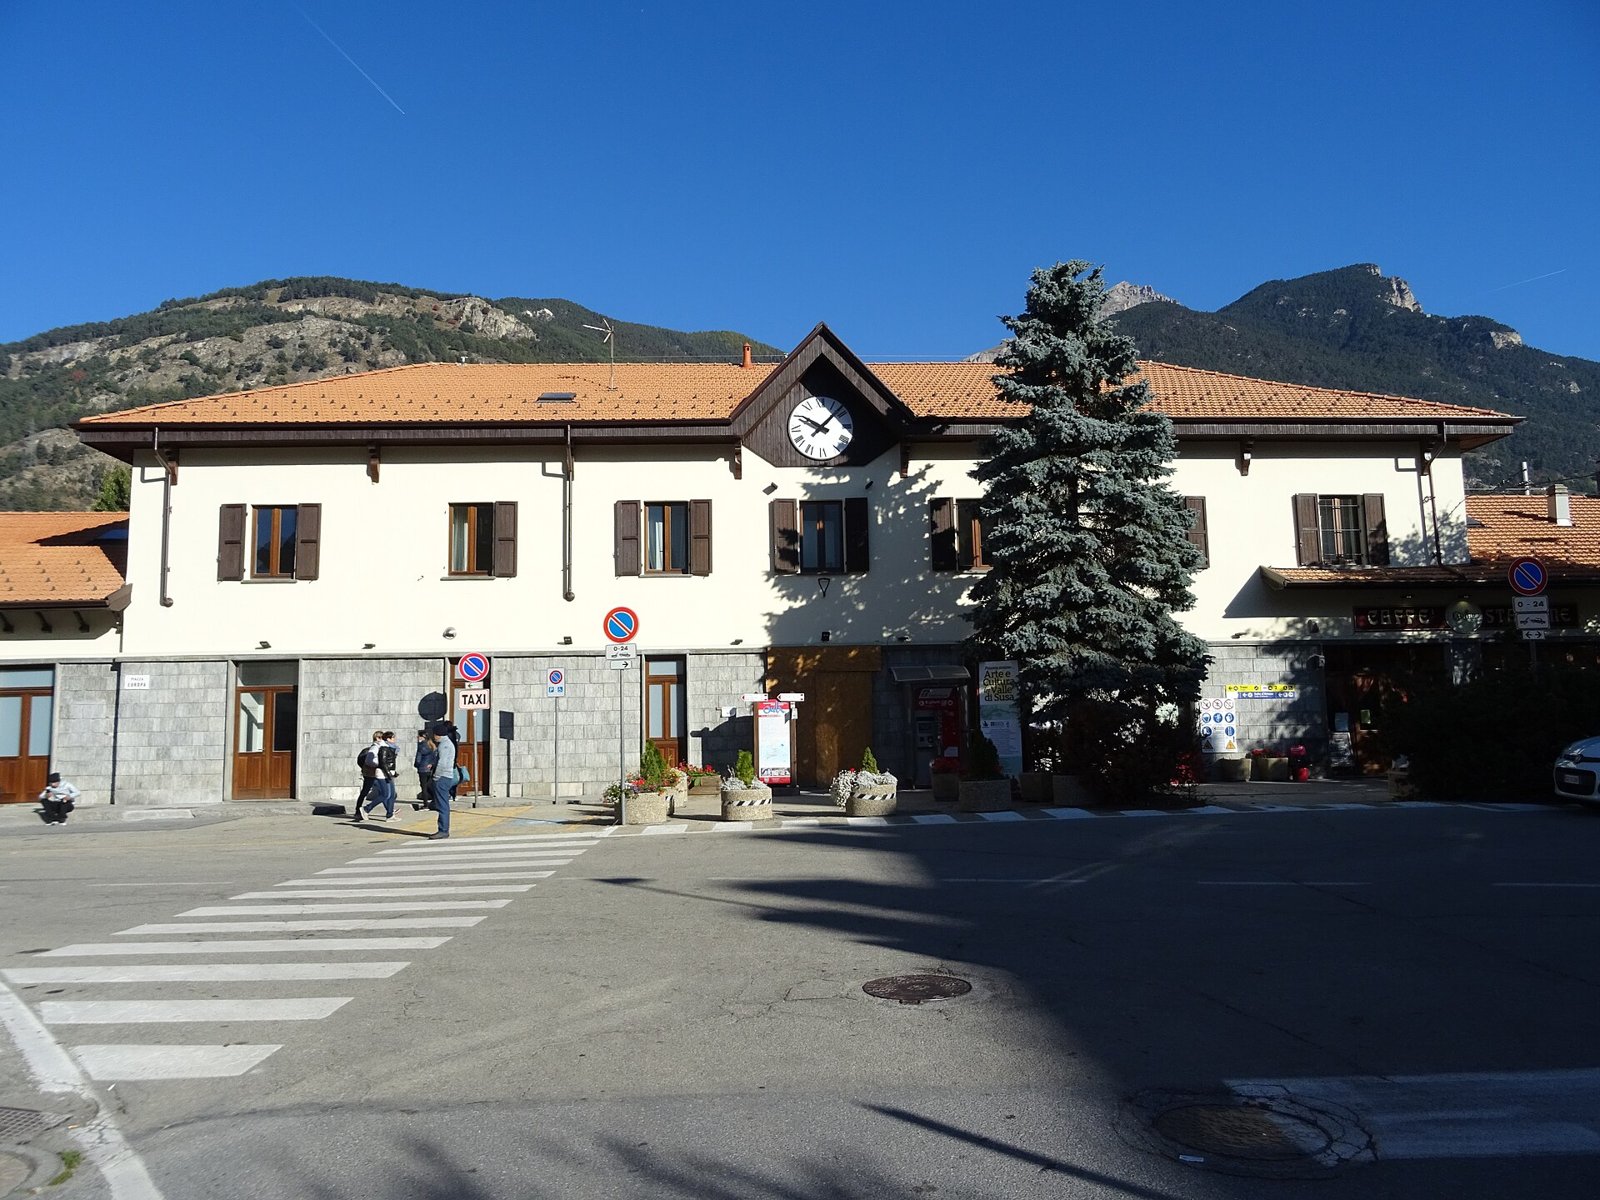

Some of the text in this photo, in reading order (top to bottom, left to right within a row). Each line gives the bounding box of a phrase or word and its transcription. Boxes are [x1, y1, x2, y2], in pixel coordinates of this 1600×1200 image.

[991, 686, 1013, 694] Valle
[462, 693, 486, 705] TAXI
[984, 693, 1014, 702] di Susa
